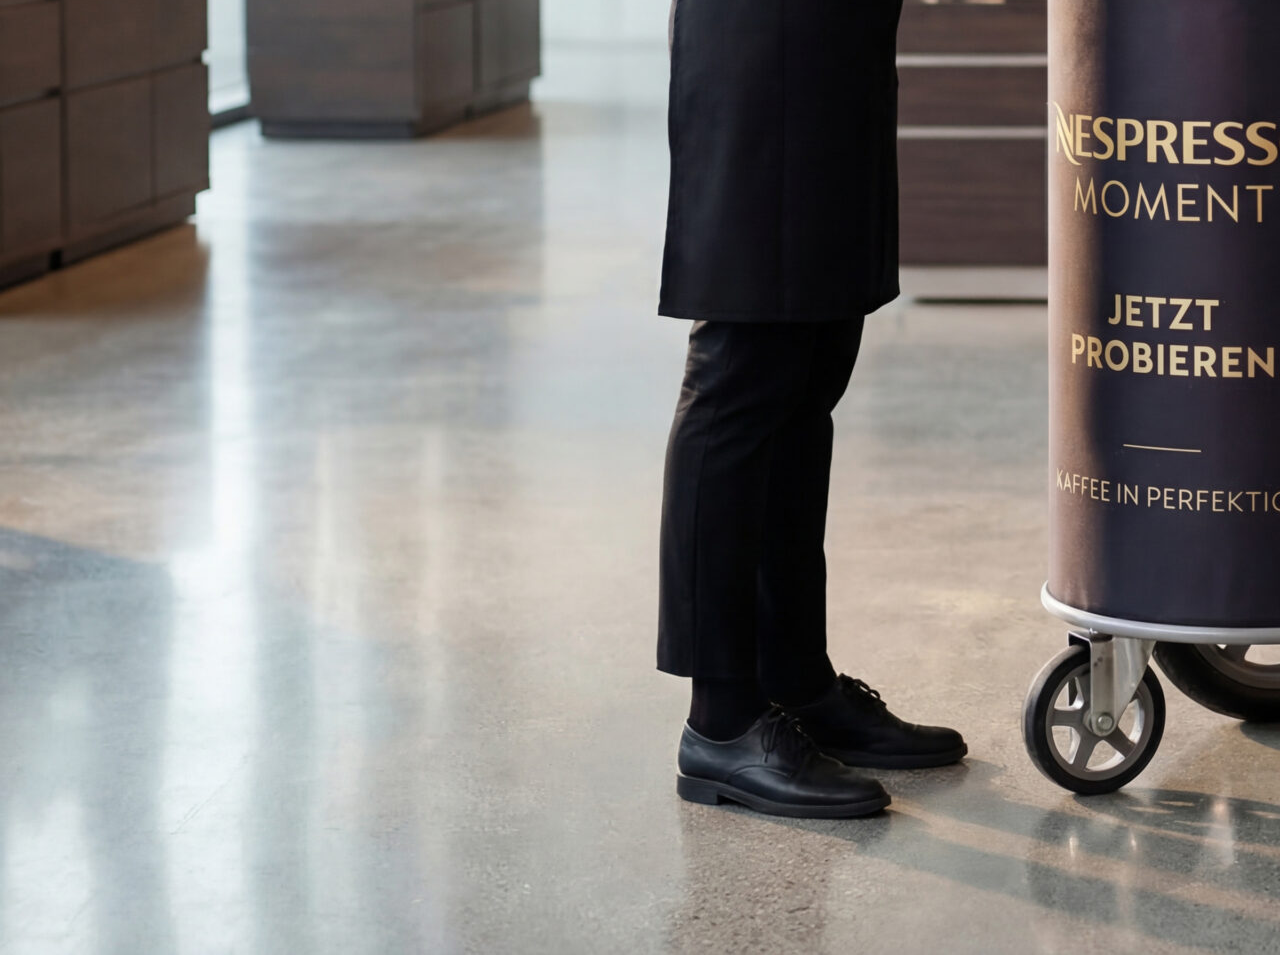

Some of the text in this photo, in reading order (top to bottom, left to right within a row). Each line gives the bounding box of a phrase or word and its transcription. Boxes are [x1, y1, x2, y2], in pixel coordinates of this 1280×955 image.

[1074, 176, 1273, 223] MOMENT
[1107, 293, 1219, 331] JETZT
[1071, 333, 1275, 378] PROBIEREN
[1056, 467, 1110, 502] KAFFEE
[1117, 482, 1138, 506] IN
